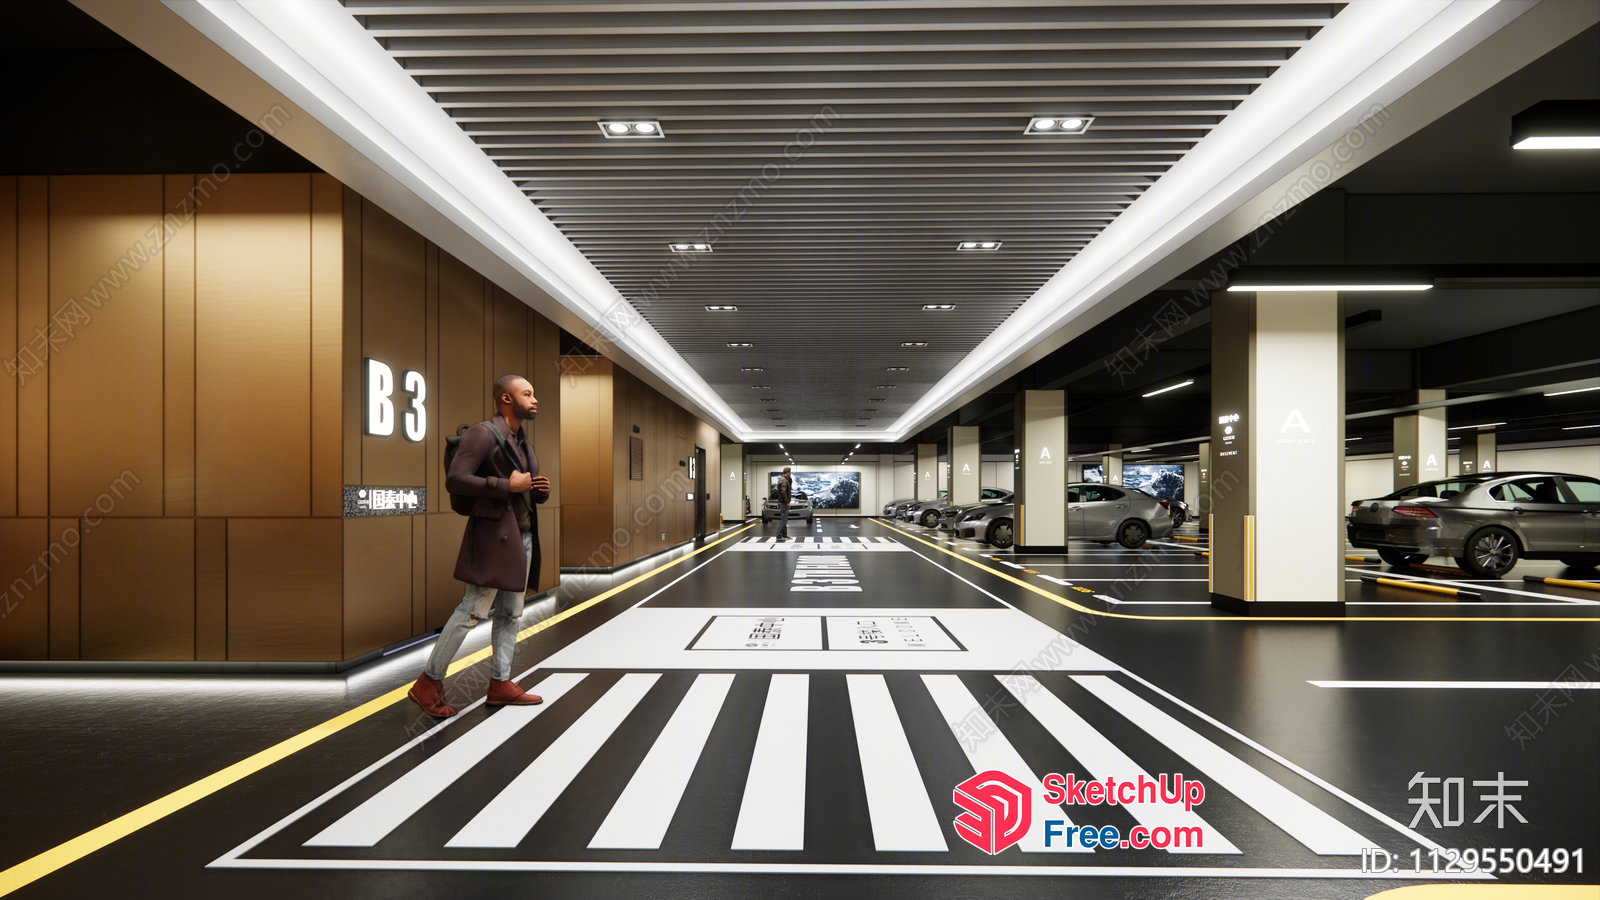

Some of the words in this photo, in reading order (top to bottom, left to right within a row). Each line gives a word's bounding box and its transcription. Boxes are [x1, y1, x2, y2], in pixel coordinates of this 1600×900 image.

[1280, 409, 1311, 433] A
[1040, 446, 1051, 459] A
[1426, 453, 1438, 466] A
[1482, 460, 1492, 469] A
[962, 463, 971, 472] A
